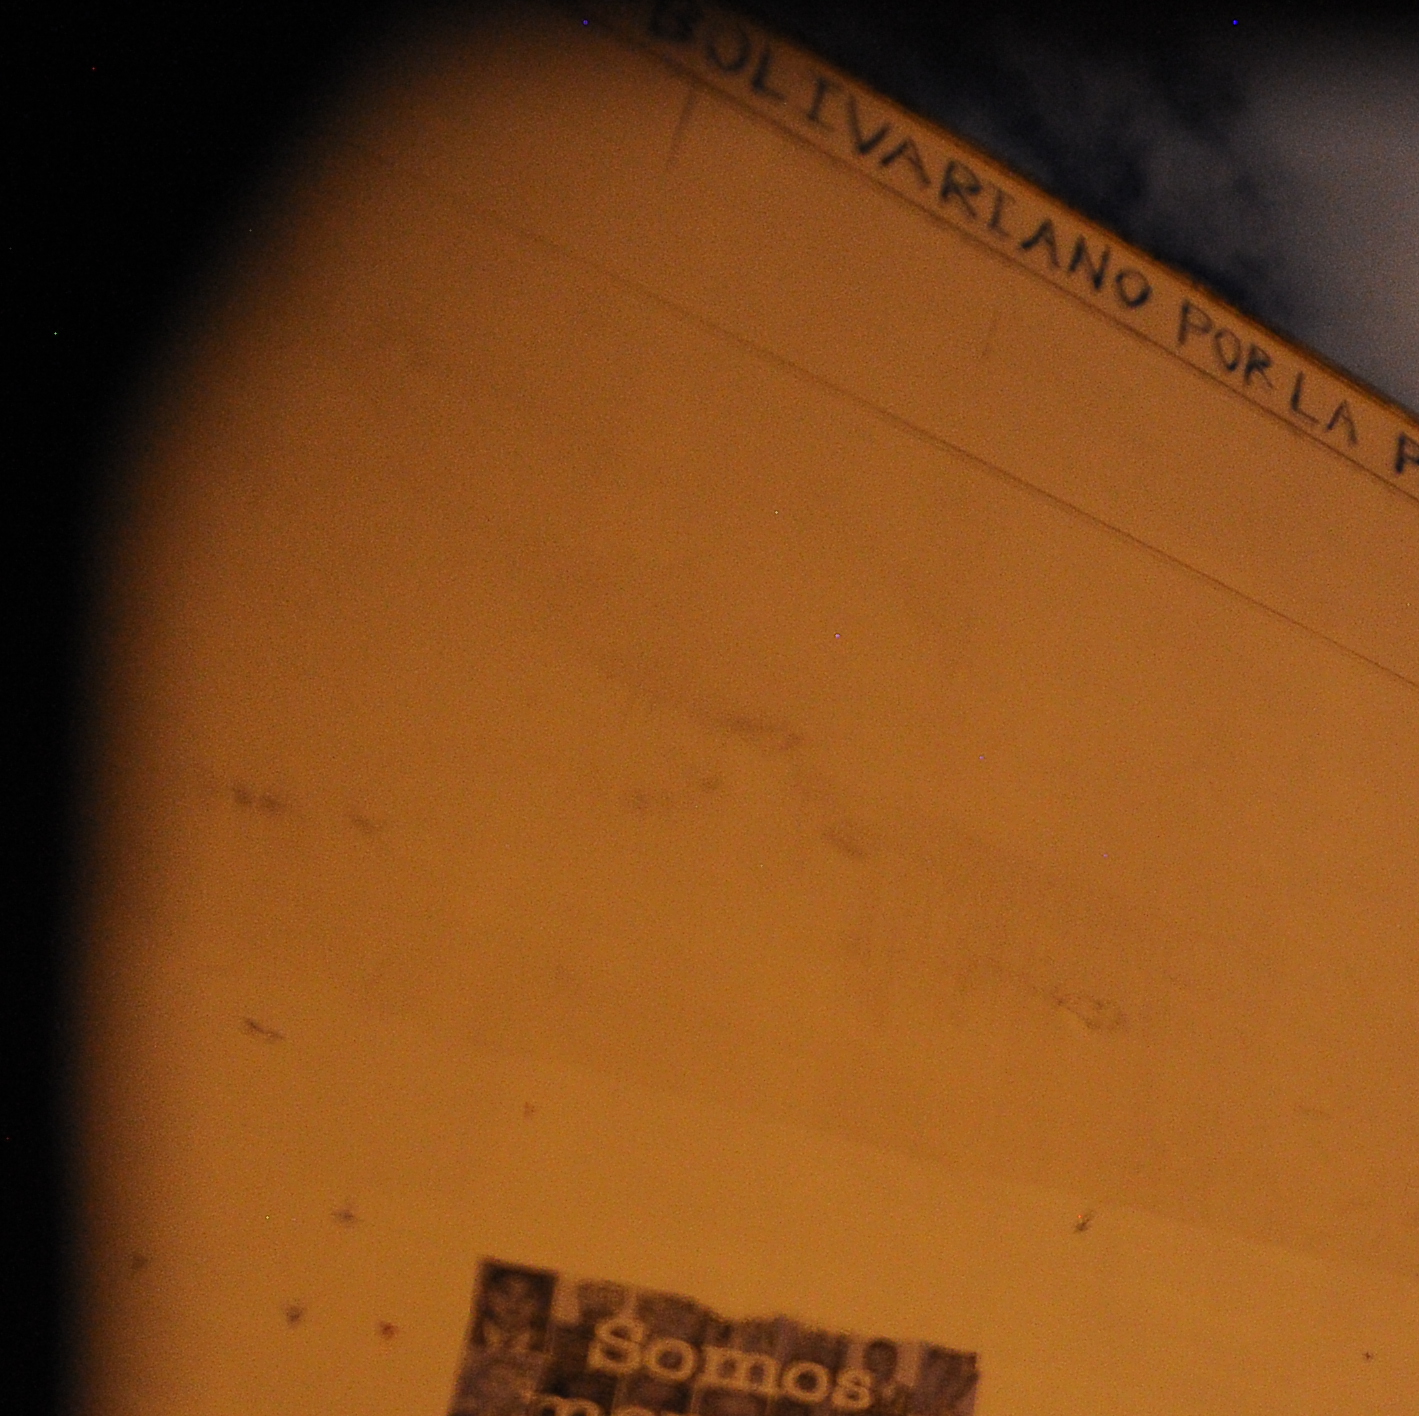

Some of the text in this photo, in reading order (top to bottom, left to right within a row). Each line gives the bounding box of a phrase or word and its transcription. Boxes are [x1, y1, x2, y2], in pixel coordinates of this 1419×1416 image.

[646, 0, 1154, 312] BOLIVARIANO
[1177, 301, 1276, 390] POR
[1290, 369, 1360, 447] LA
[587, 1316, 875, 1412] Somos
